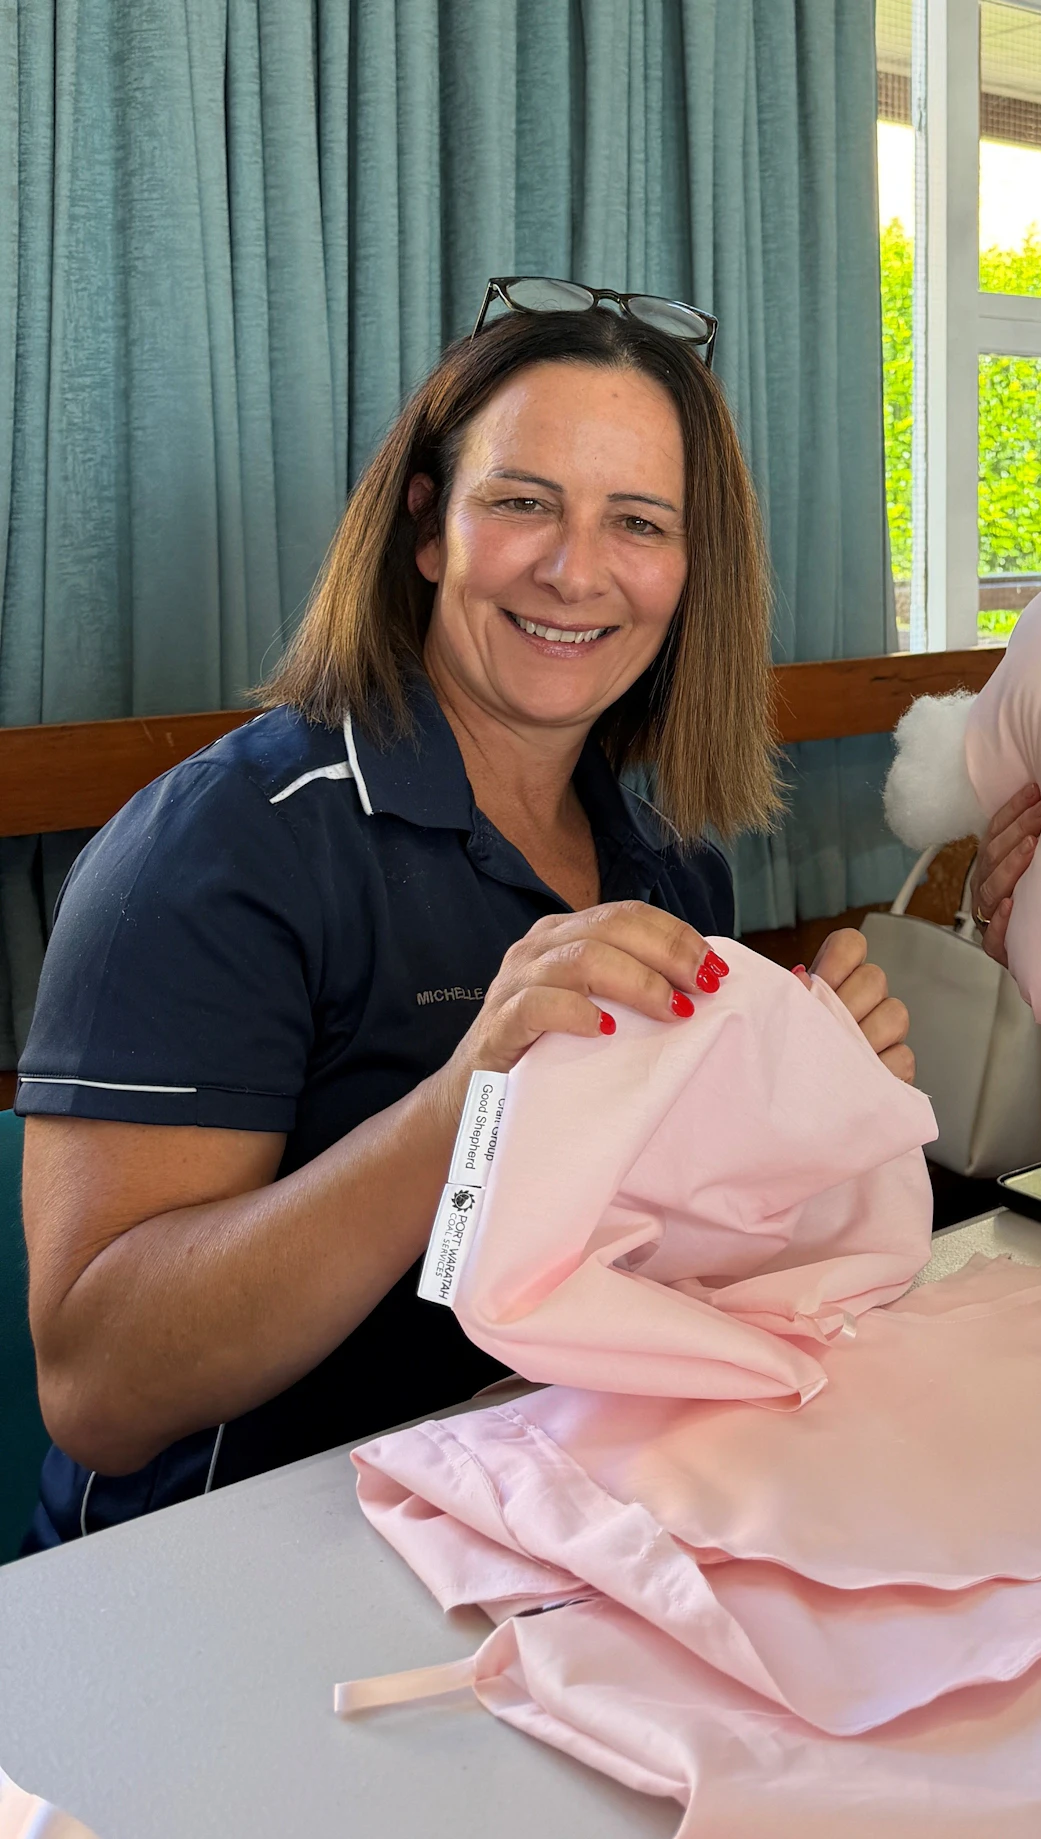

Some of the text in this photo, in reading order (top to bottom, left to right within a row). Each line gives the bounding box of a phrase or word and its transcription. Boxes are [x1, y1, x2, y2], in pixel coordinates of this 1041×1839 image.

[416, 986, 484, 1006] MICHELLE
[465, 1084, 494, 1170] Good Shepherd
[484, 1127, 499, 1162] Group
[435, 1212, 457, 1277] COAL SERVICES
[438, 1215, 468, 1300] PORT WARATAH
